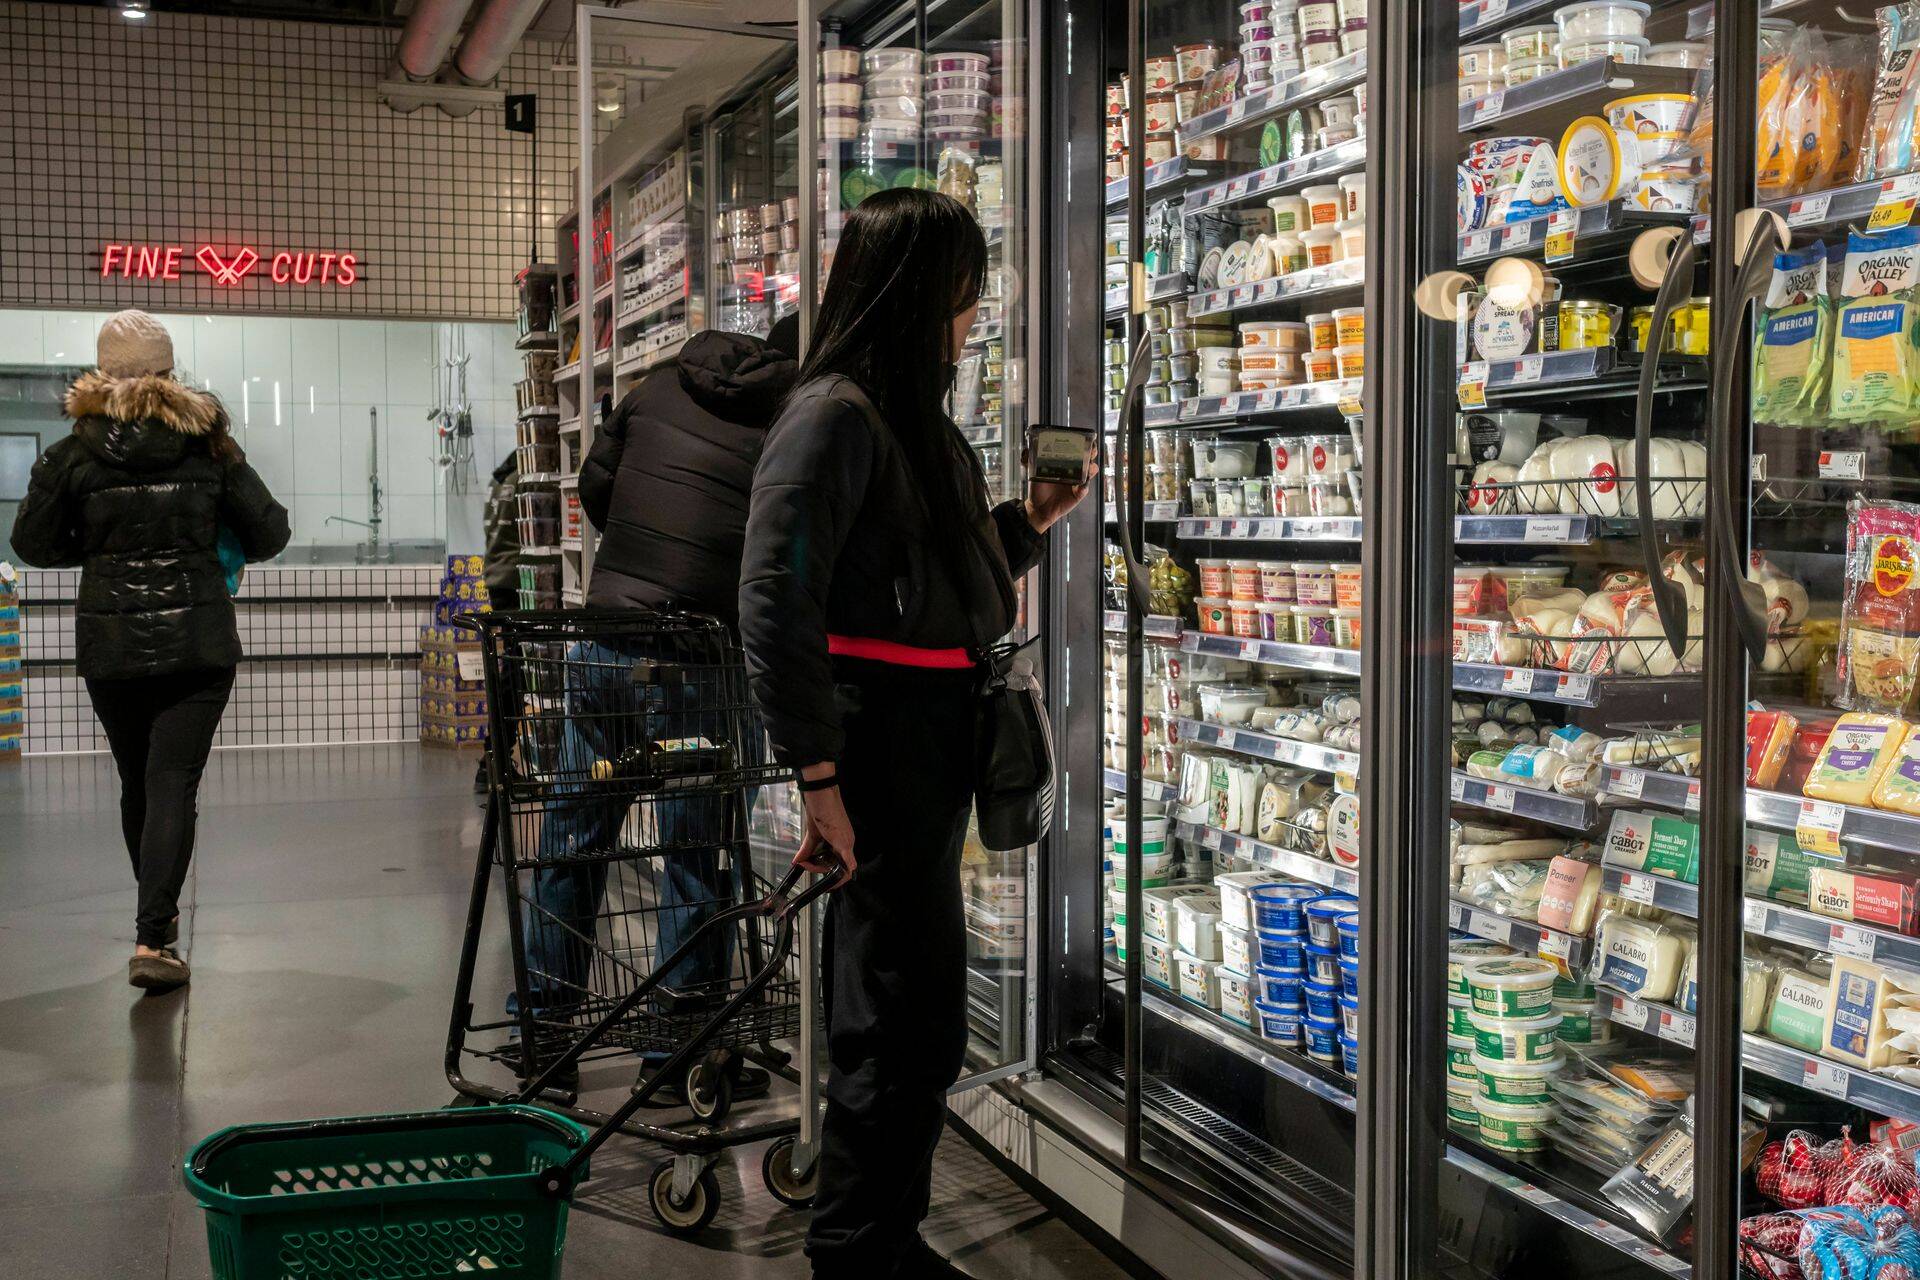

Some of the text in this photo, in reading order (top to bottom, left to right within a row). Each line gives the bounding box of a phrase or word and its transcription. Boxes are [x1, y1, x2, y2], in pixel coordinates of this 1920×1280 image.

[512, 101, 523, 122] 1
[1804, 136, 1814, 145] 10
[1870, 208, 1892, 224] $6.49
[102, 244, 356, 285] FINE CUTS
[1858, 255, 1913, 275] ORGANIC
[1860, 268, 1907, 284] VALLEY
[1494, 310, 1515, 318] SPREAD
[1849, 309, 1895, 324] AMERICAN
[1772, 315, 1814, 333] AMERICAN
[1875, 560, 1912, 573] JARLSBERG
[1845, 732, 1873, 743] ORGANIC
[1847, 737, 1870, 746] VALLEY
[1839, 754, 1863, 763] MUENSTER
[1841, 759, 1857, 768] CHEESE
[1653, 831, 1687, 847] Vermont Sharp
[1798, 831, 1816, 847] $6.49
[1614, 845, 1637, 855] CREAMERY
[1779, 848, 1819, 865] Vermont Sharp
[1745, 854, 1771, 870] BOT
[1550, 868, 1576, 884] Paneer
[1855, 885, 1877, 894] VERMONT
[1824, 905, 1844, 913] CREAMERY
[1855, 891, 1899, 911] Seriously Sharp
[1855, 902, 1888, 915] CHEDDAR CHEESE
[1612, 941, 1647, 962] CALABRO
[1609, 966, 1641, 984] MOZZARELLA
[1781, 986, 1824, 1010] CALABRO
[1775, 1013, 1817, 1034] MOZZARELLA
[1646, 1132, 1680, 1166] FLAGSHIP
[1640, 1179, 1660, 1196] FLAGSHIP
